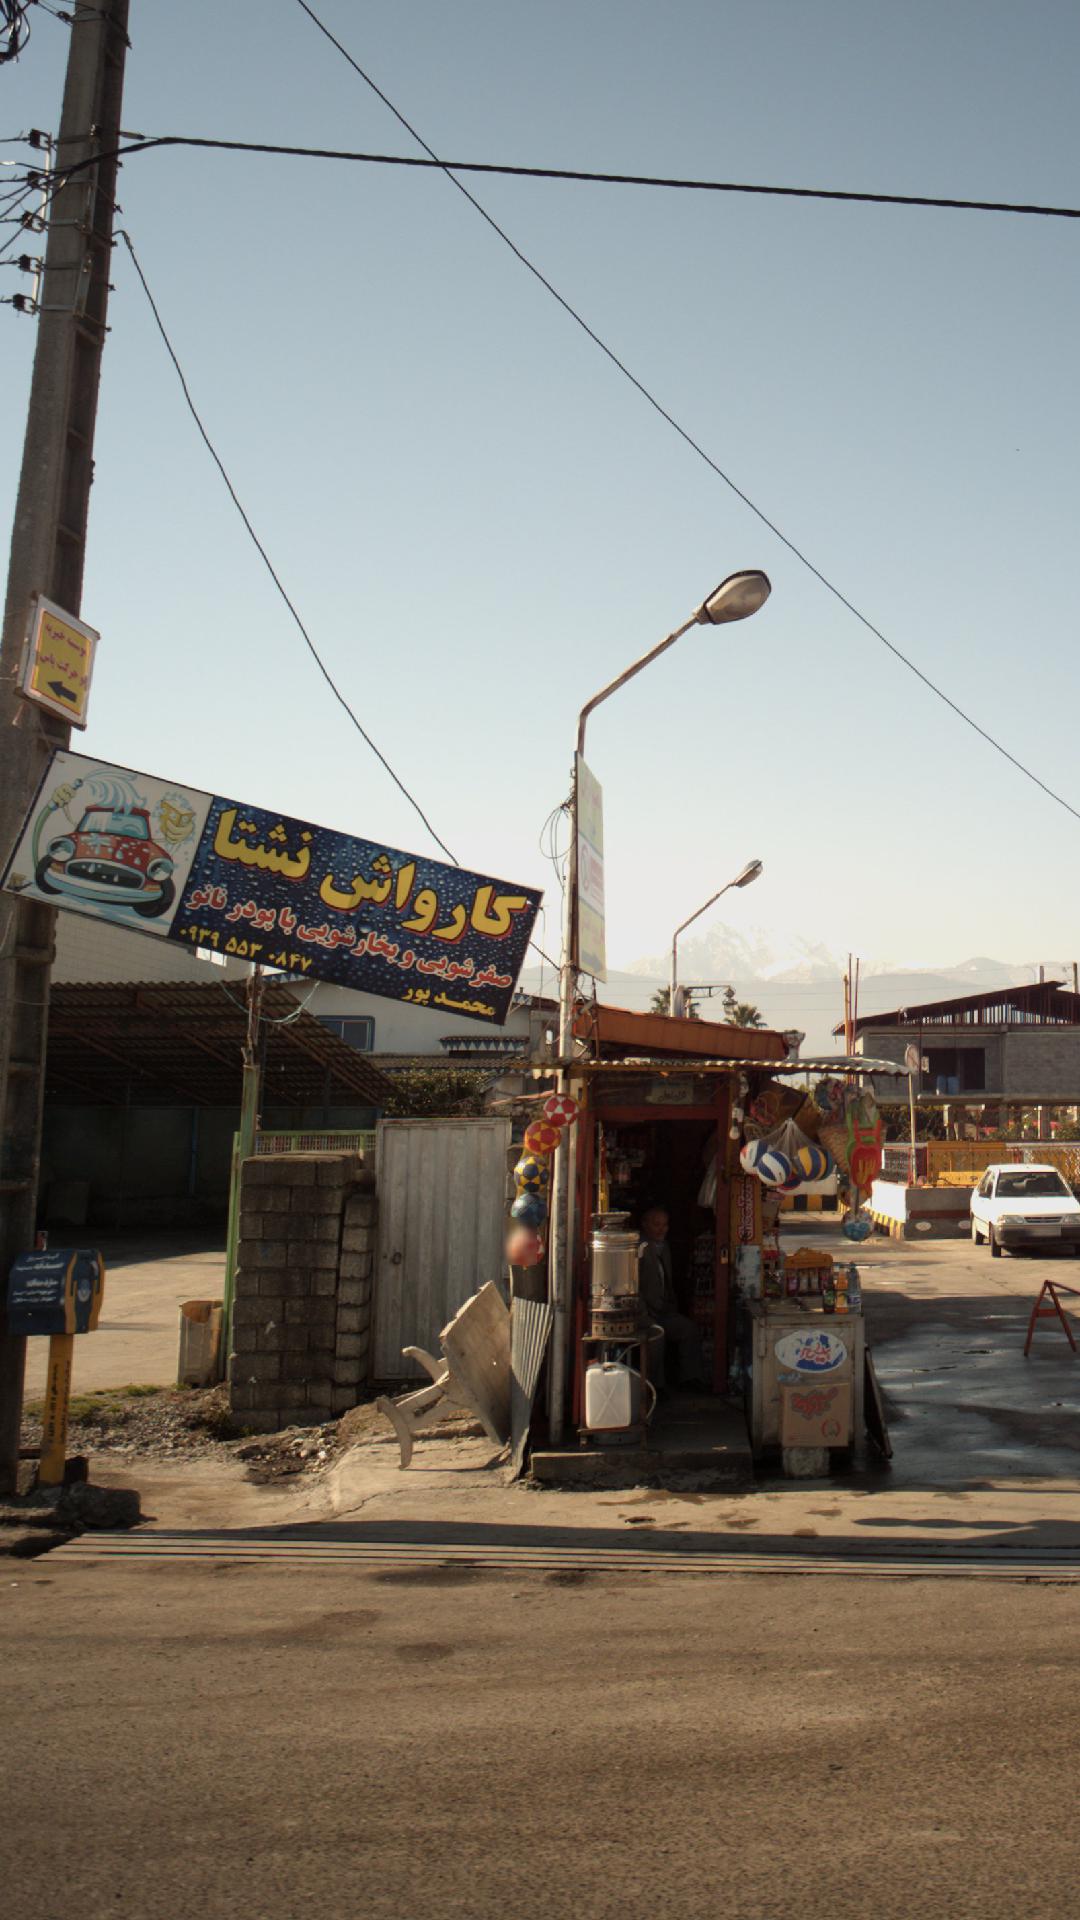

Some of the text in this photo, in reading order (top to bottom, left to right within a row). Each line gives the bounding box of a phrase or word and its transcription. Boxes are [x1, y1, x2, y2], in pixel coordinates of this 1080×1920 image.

[213, 808, 312, 882] نشتا
[186, 884, 228, 910] نانو
[319, 854, 529, 944] کارواش
[225, 900, 277, 931] پودر
[278, 906, 297, 936] با
[398, 949, 416, 969] و
